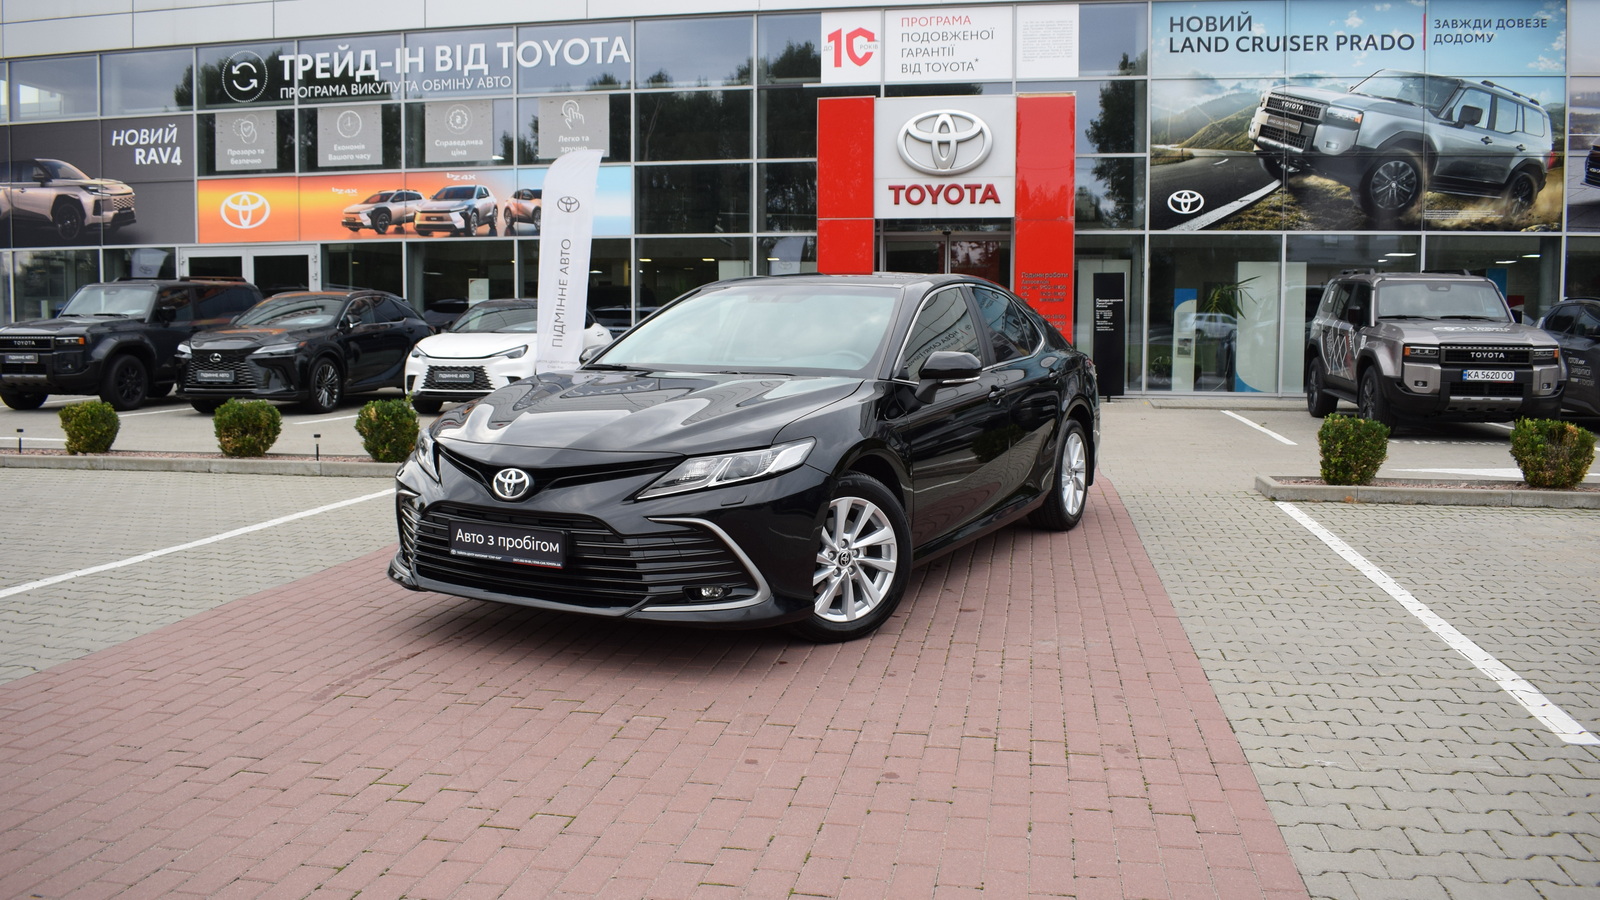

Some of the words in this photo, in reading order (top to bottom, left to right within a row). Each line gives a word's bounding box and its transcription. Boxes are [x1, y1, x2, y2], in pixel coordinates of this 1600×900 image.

[901, 15, 972, 28] ПРОГРАМА
[1169, 11, 1253, 33] НОВИЙ
[1433, 19, 1492, 31] ЗАВЖДИ
[1495, 18, 1548, 31] ДОВЕЗЕ
[901, 27, 995, 44] ПОДОВЖЕНОЇ
[1433, 33, 1495, 45] ДОДОМУ
[1169, 36, 1230, 53] LAND
[1235, 35, 1329, 53] CRUISER
[1336, 34, 1416, 51] PRADO
[901, 44, 956, 58] ГАРАНТІЇ
[278, 44, 425, 83] ТРЕЙД-ІН
[435, 43, 489, 76] ВІД
[496, 36, 631, 69] TOYOTA
[901, 63, 922, 75] ВІД
[279, 84, 349, 99] ПРОГРАМА
[351, 81, 402, 96] ВИКУПУ
[404, 80, 419, 92] ТА
[422, 77, 475, 92] ОБМІНУ
[477, 75, 512, 89] АВТО
[1281, 101, 1304, 111] TOYOTA
[111, 123, 178, 147] НОВИЙ
[558, 135, 580, 143] Легко
[333, 142, 366, 151] Економія
[434, 139, 484, 147] Справедлива
[134, 146, 183, 166] RAV4
[226, 148, 255, 156] Прозоро
[328, 153, 353, 161] Вашого
[355, 153, 371, 161] часу
[450, 148, 467, 157] ціна
[230, 157, 262, 165] безпечно
[888, 183, 1001, 206] TOYOTA
[559, 238, 572, 275] АВТО
[551, 279, 568, 348] ПІДМІННЕ
[1470, 351, 1505, 359] TOYOTA
[1467, 371, 1480, 379] KA
[1481, 371, 1500, 380] 5620
[455, 528, 485, 545] Авто
[487, 535, 495, 546] з
[498, 535, 560, 554] пробігом
